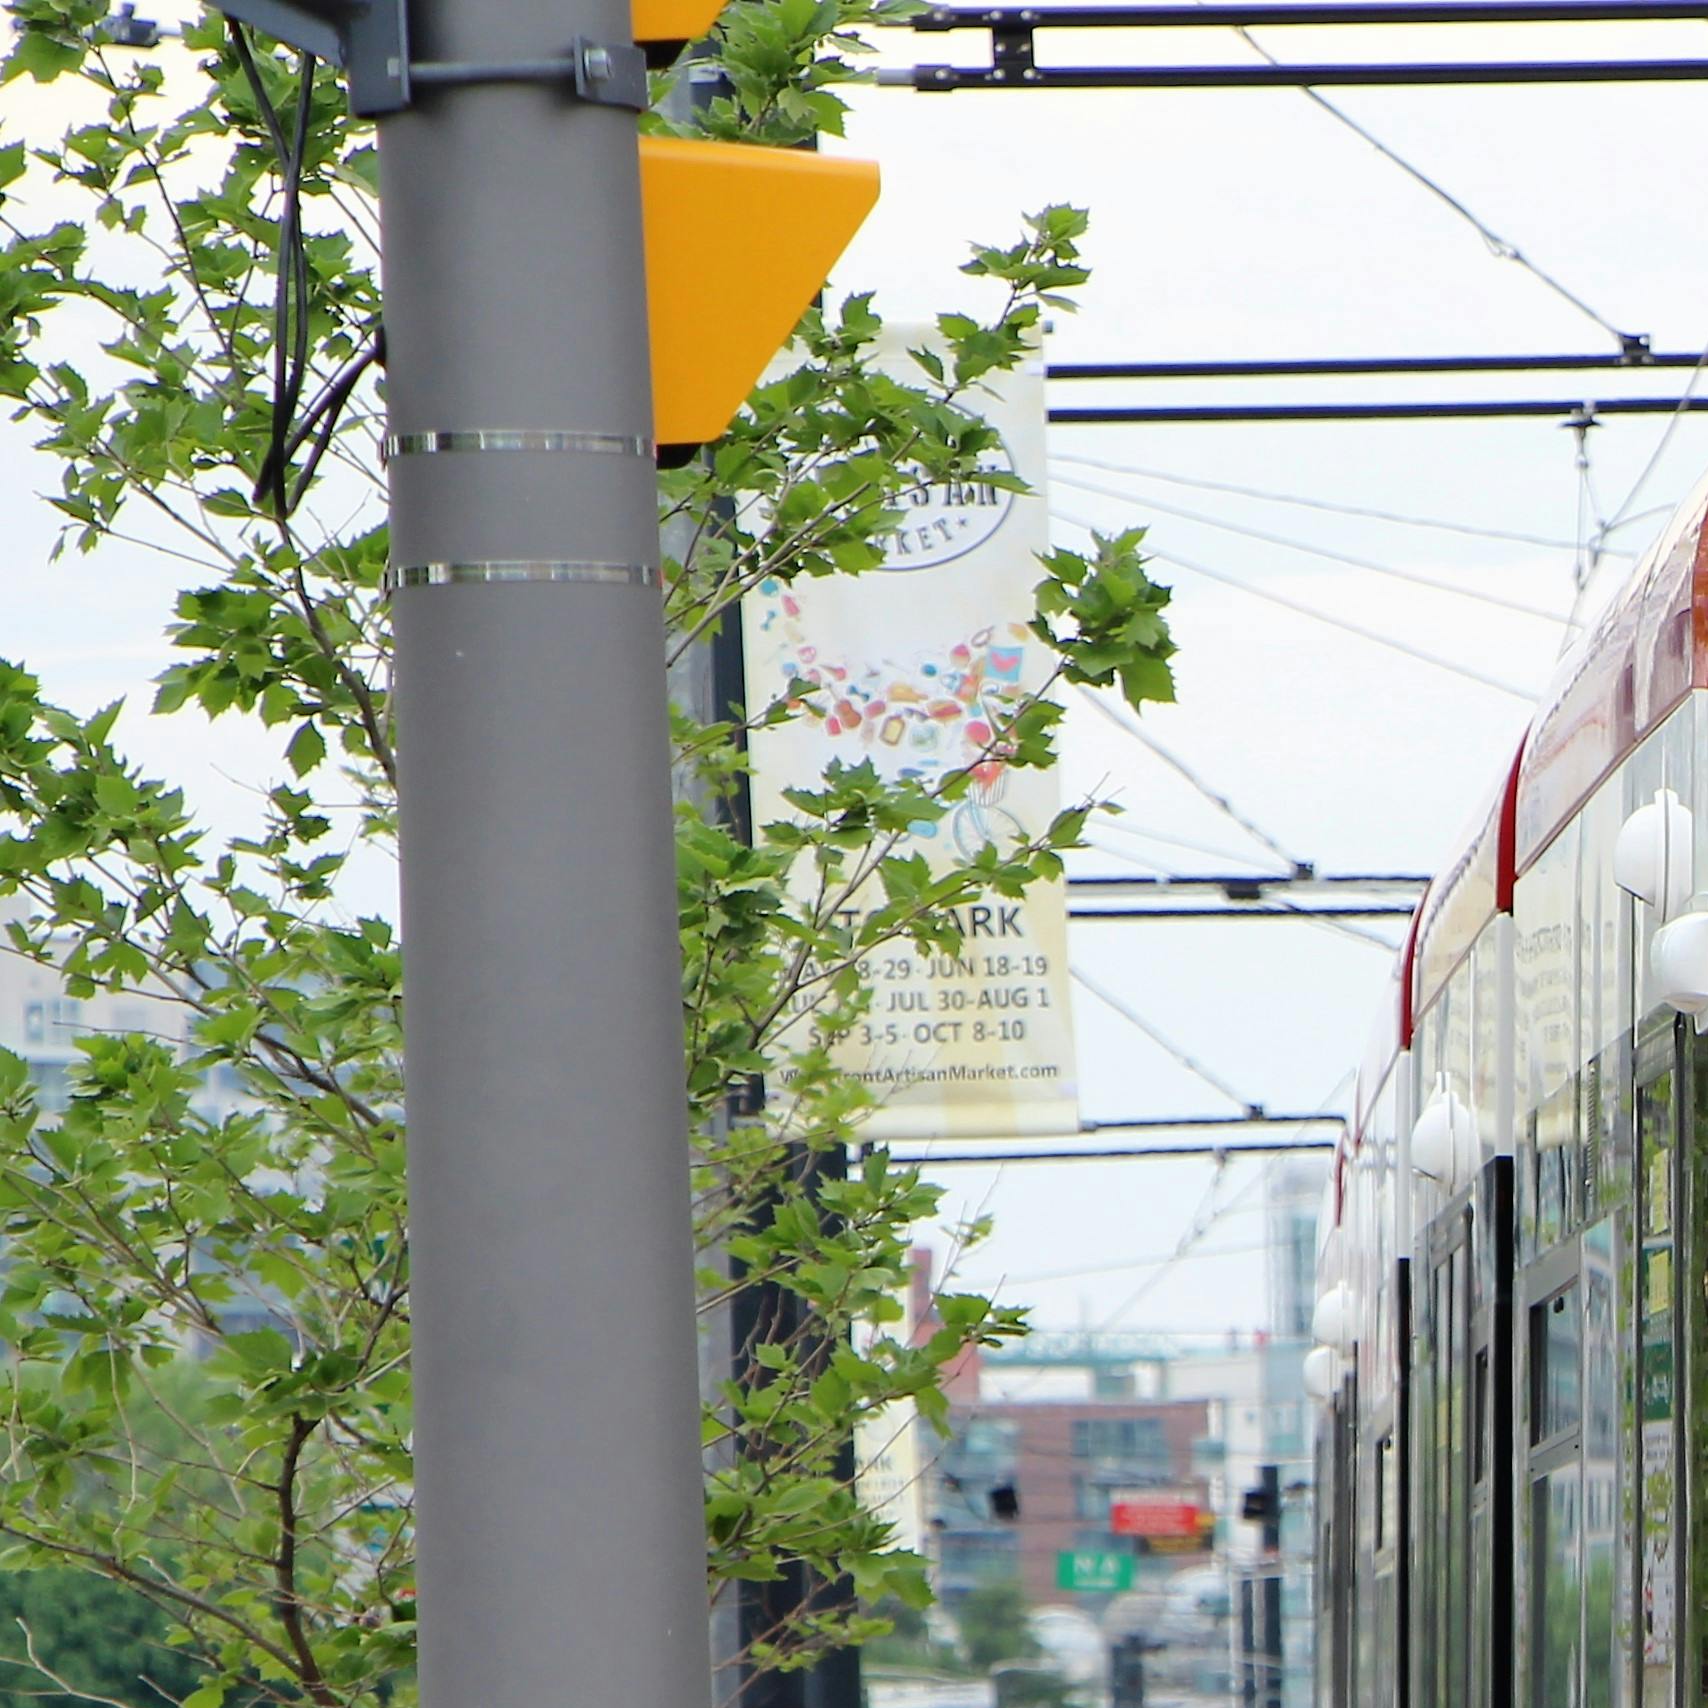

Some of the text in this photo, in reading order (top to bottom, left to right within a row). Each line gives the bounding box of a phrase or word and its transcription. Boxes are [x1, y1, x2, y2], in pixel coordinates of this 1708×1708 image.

[858, 958, 911, 981] 8-29
[926, 956, 976, 981] JUN
[983, 955, 1048, 978] 18-19
[885, 989, 930, 1014] JUL
[937, 986, 1028, 1010] 30-AUG
[860, 1023, 898, 1046] 3-5
[912, 1021, 963, 1043] OCT
[972, 1020, 1026, 1042] 8-10
